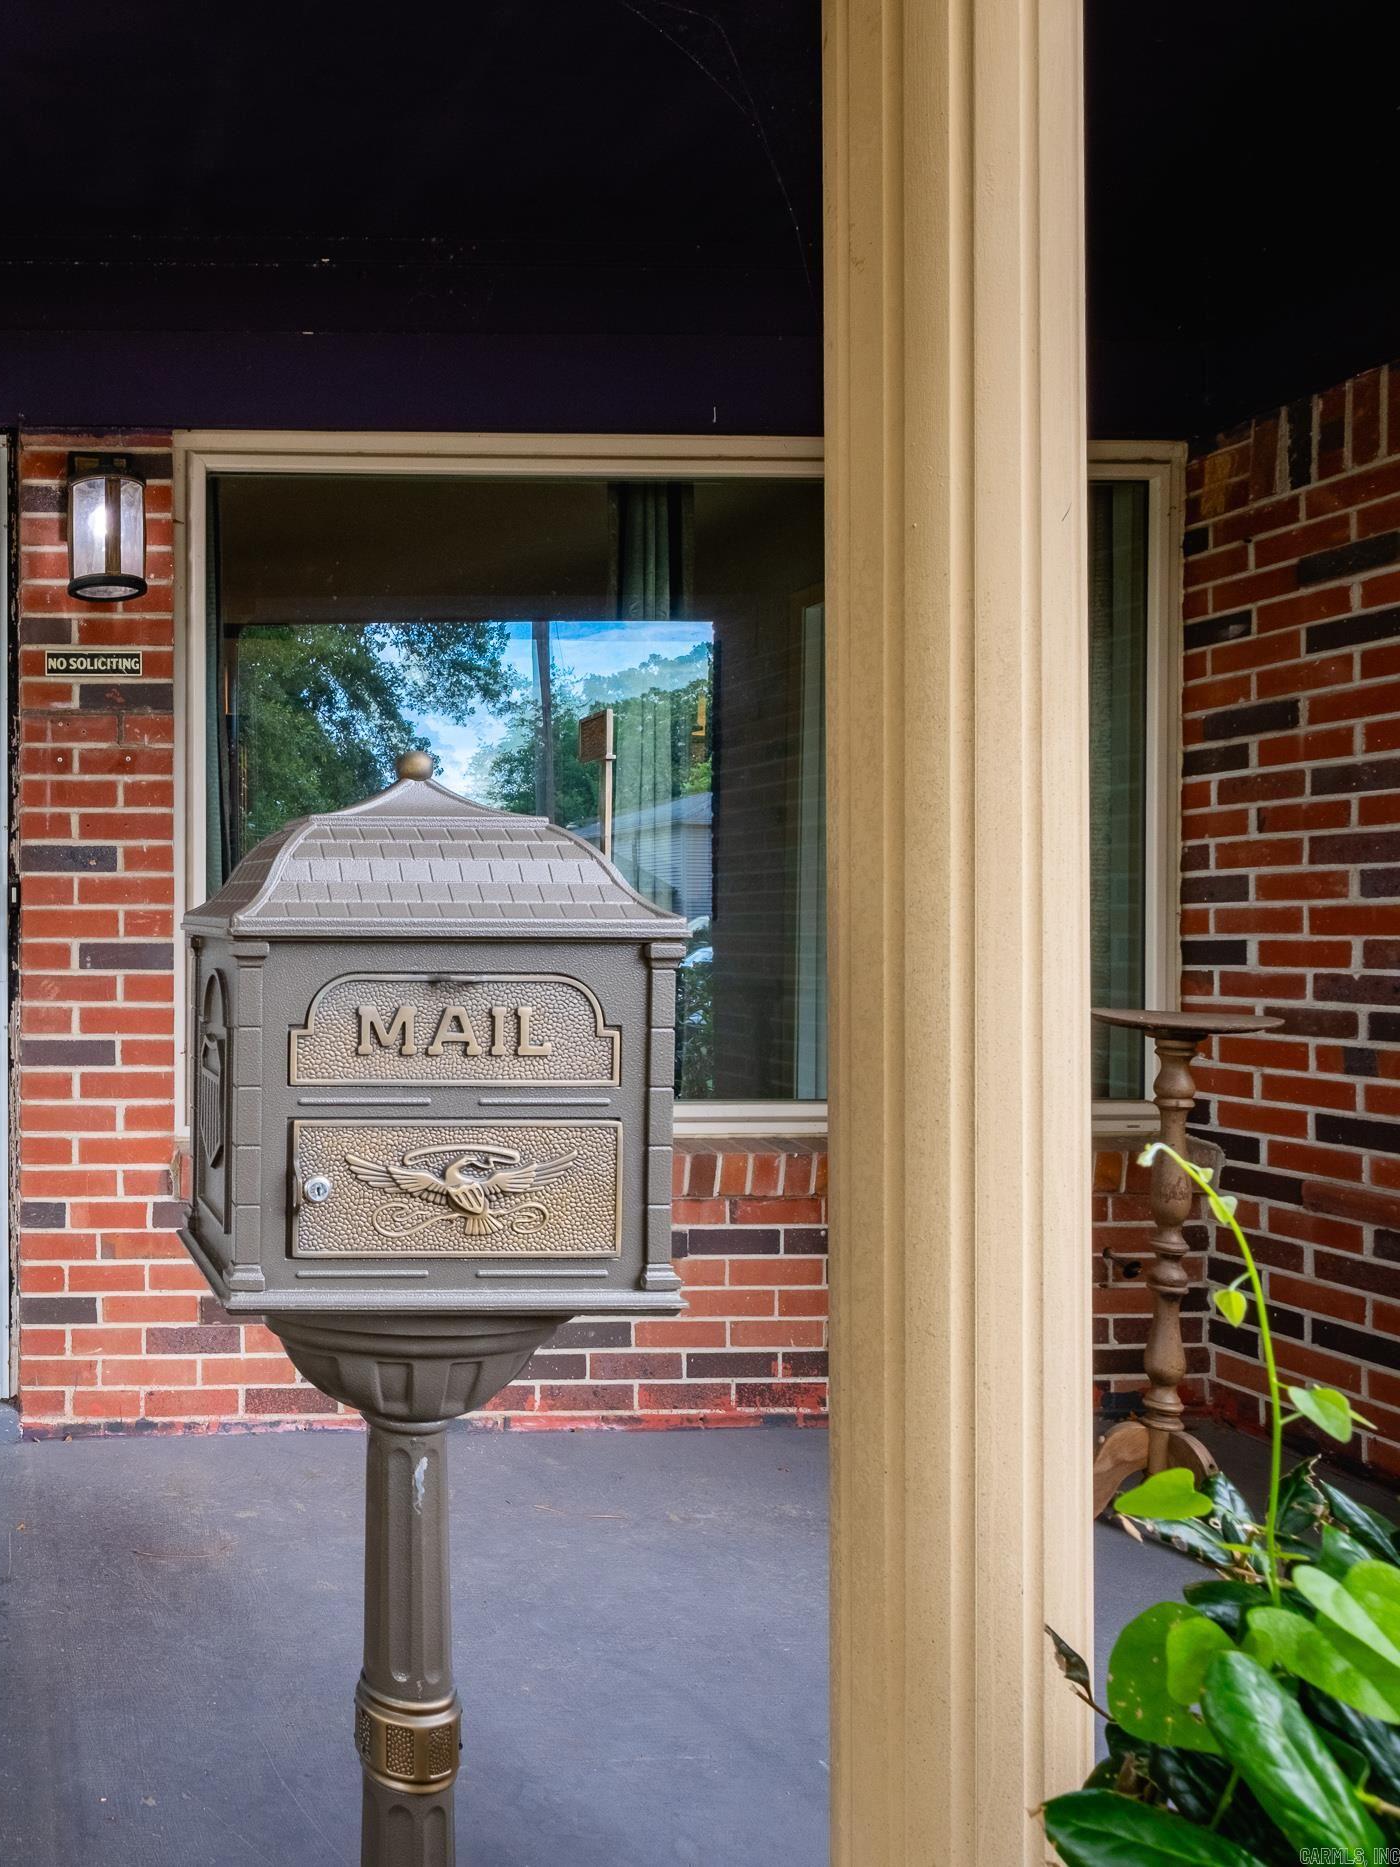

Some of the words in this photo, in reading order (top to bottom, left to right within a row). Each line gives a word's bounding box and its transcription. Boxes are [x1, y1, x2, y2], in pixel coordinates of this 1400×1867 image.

[48, 657, 67, 670] NO
[69, 657, 140, 670] SOLICITING
[357, 1005, 552, 1056] MAIL
